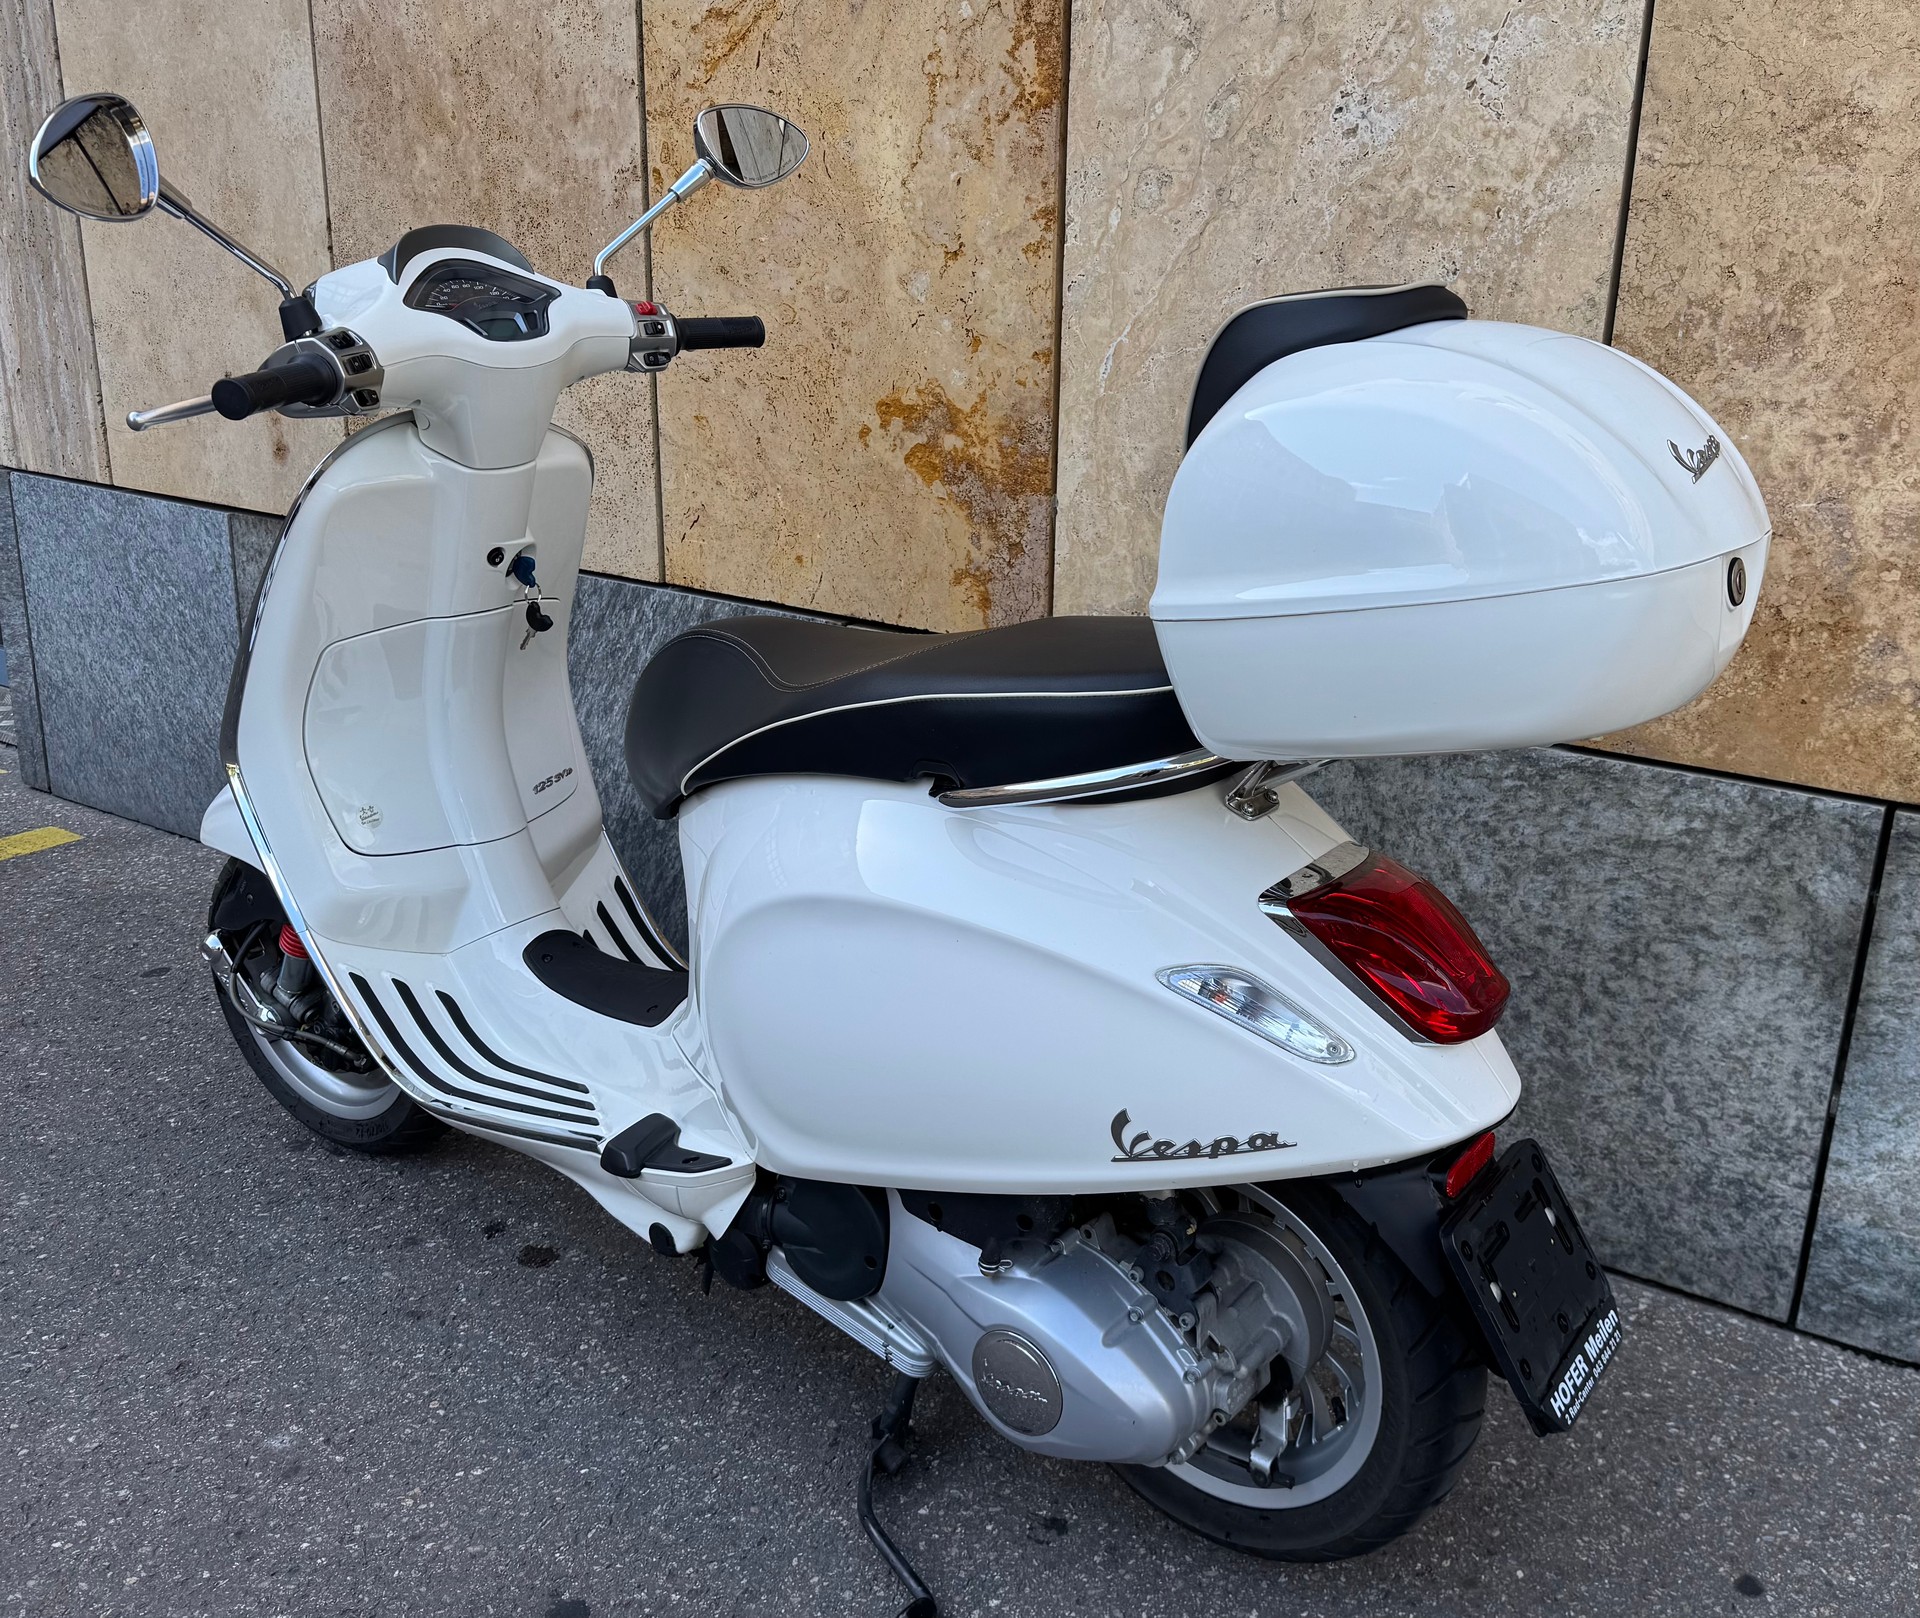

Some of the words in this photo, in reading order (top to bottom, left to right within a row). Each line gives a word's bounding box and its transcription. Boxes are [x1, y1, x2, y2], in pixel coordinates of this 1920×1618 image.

[1667, 434, 1721, 485] Vespa
[532, 775, 554, 795] 125
[1110, 1107, 1298, 1163] Vespa
[1550, 1354, 1589, 1418] HOFER
[1583, 1309, 1619, 1363] Meilen
[1565, 1413, 1572, 1425] 2
[1569, 1377, 1595, 1419] Rad-Center
[1593, 1360, 1604, 1378] 043
[1600, 1347, 1612, 1366] 844
[1610, 1338, 1617, 1351] 21
[1615, 1330, 1622, 1343] 21
